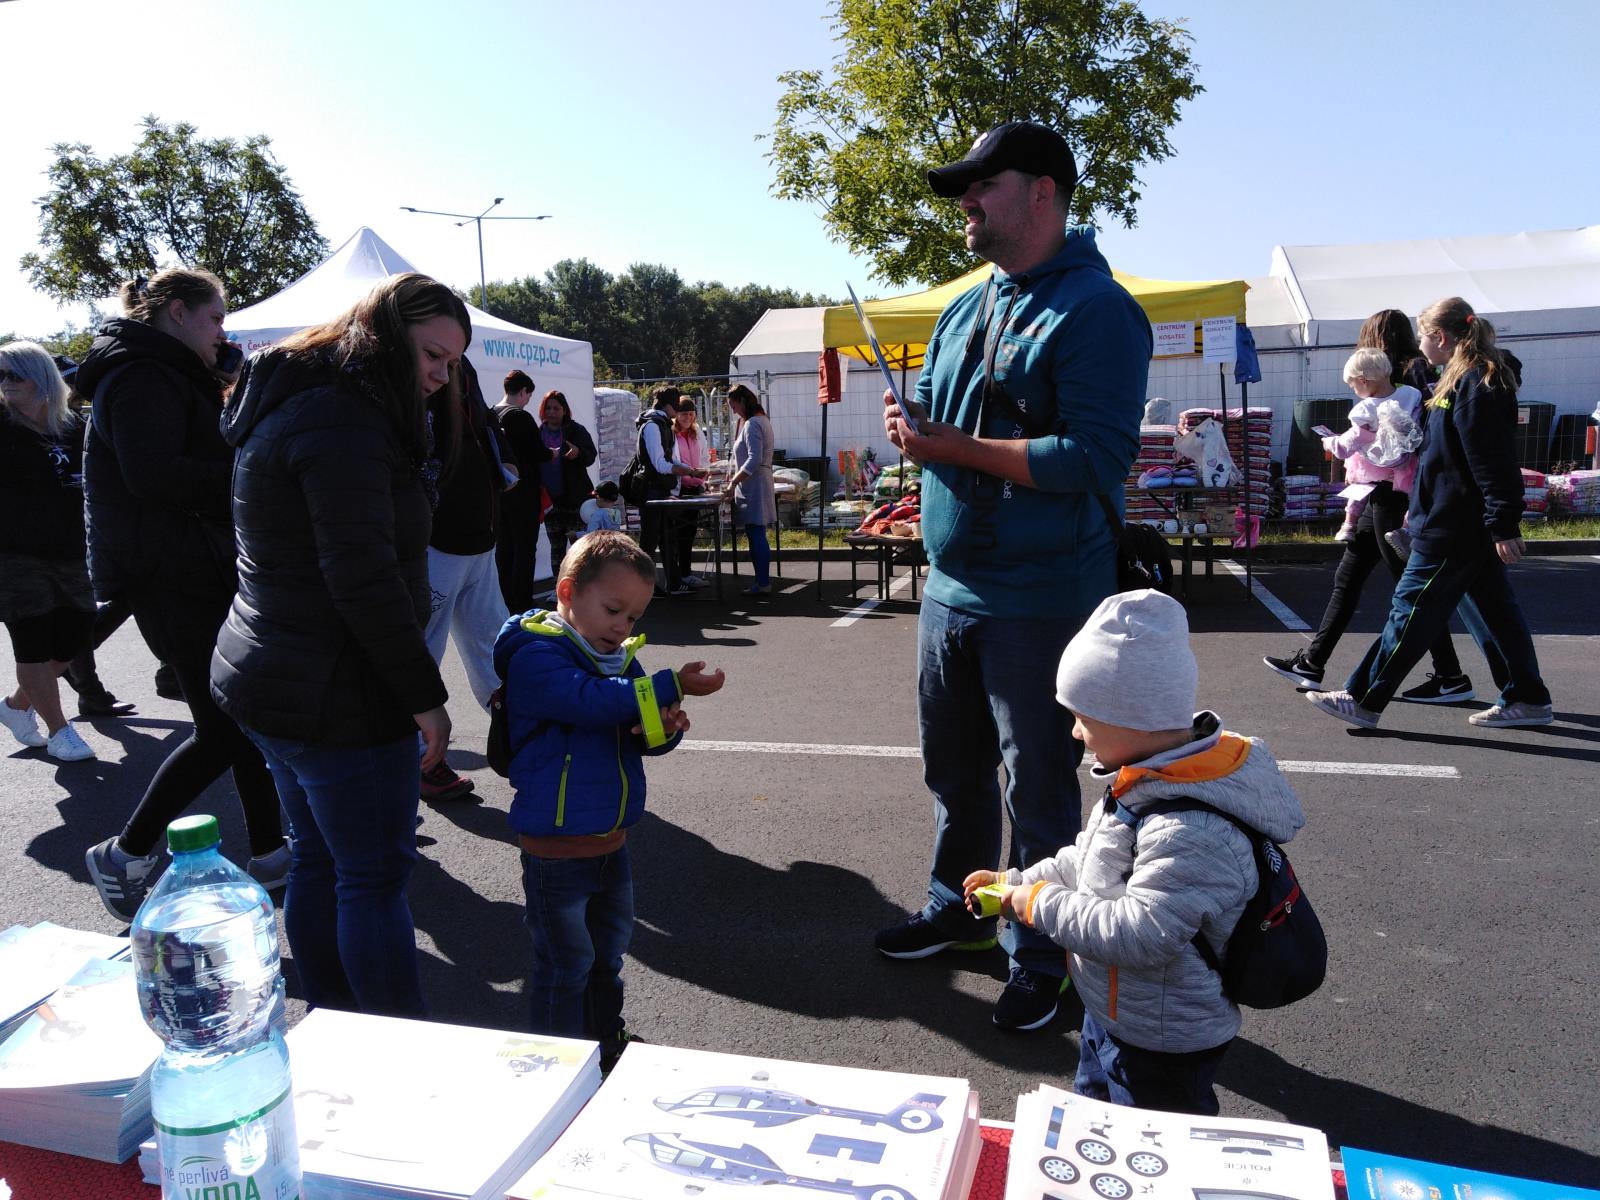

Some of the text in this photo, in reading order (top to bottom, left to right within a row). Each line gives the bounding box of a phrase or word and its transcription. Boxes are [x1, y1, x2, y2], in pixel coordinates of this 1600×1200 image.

[483, 339, 561, 367] www.cpzp.cz
[178, 1164, 229, 1186] perlivá
[1224, 1162, 1272, 1172] POLICIE
